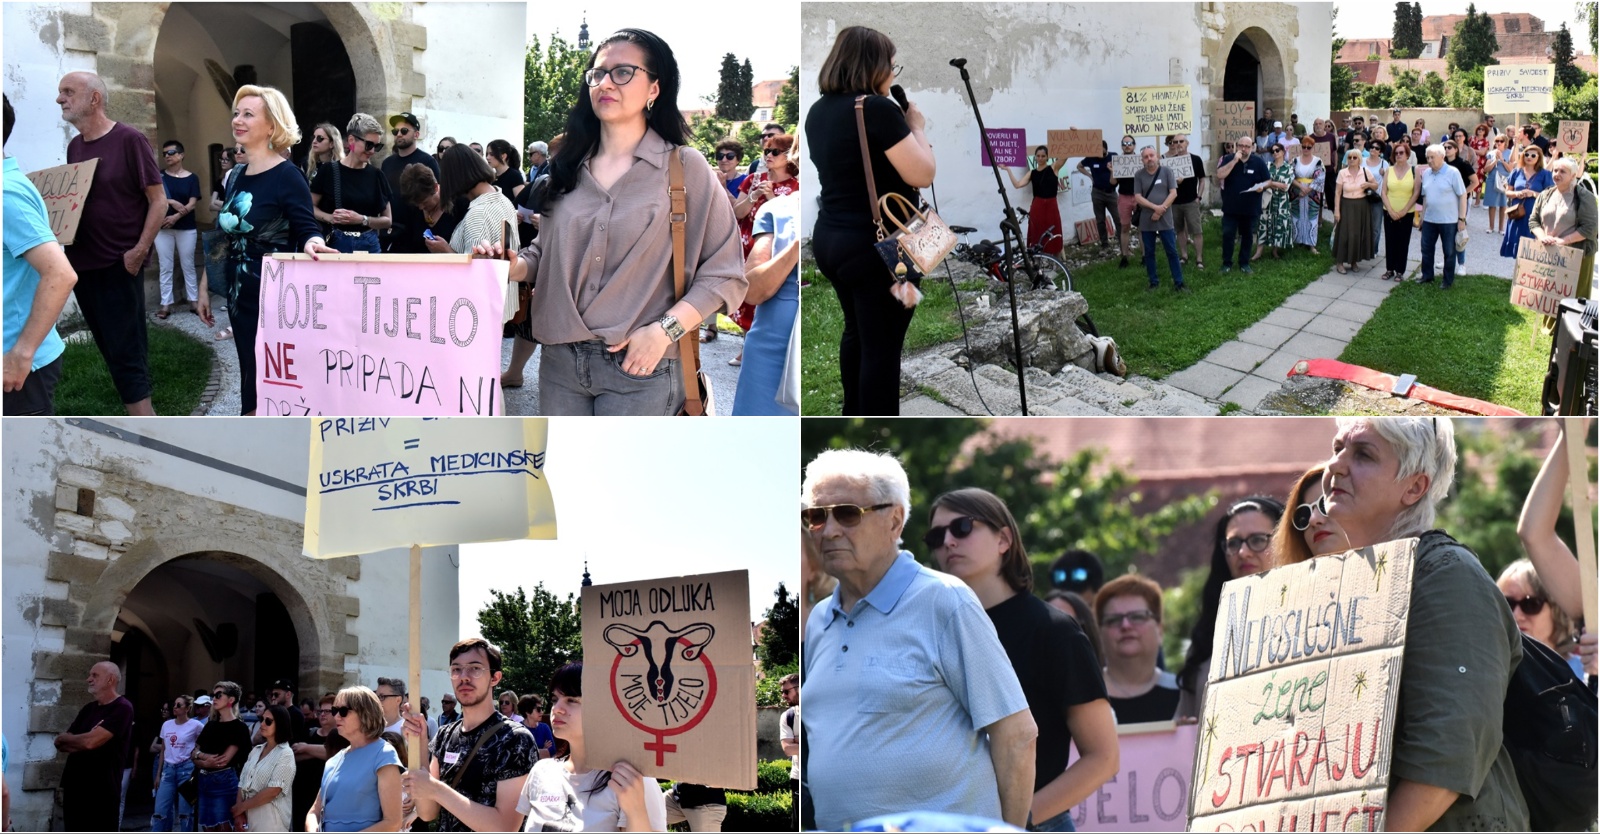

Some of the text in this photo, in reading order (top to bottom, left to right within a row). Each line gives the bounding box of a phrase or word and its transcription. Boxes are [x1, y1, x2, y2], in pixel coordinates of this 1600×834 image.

[1125, 91, 1148, 104] 81%
[986, 132, 1019, 140] OVJERILI BI
[1125, 120, 1192, 134] PRAVO NA IZBOR!
[1517, 288, 1561, 315] POVIJE
[1519, 272, 1573, 298] STVARAJU
[260, 261, 479, 348] MOJE TIJELO
[264, 341, 496, 416] NE PRIPADA NI
[319, 449, 545, 488] USKRATA MEDICINSKE
[378, 478, 439, 501] SKRBI
[600, 582, 715, 619] MOJA ODLUKA
[1219, 585, 1369, 679] NEPOSLUŠNE
[620, 674, 704, 726] MOJE TIJELO
[1252, 670, 1327, 726] žene
[1211, 716, 1381, 809] STVARAJU
